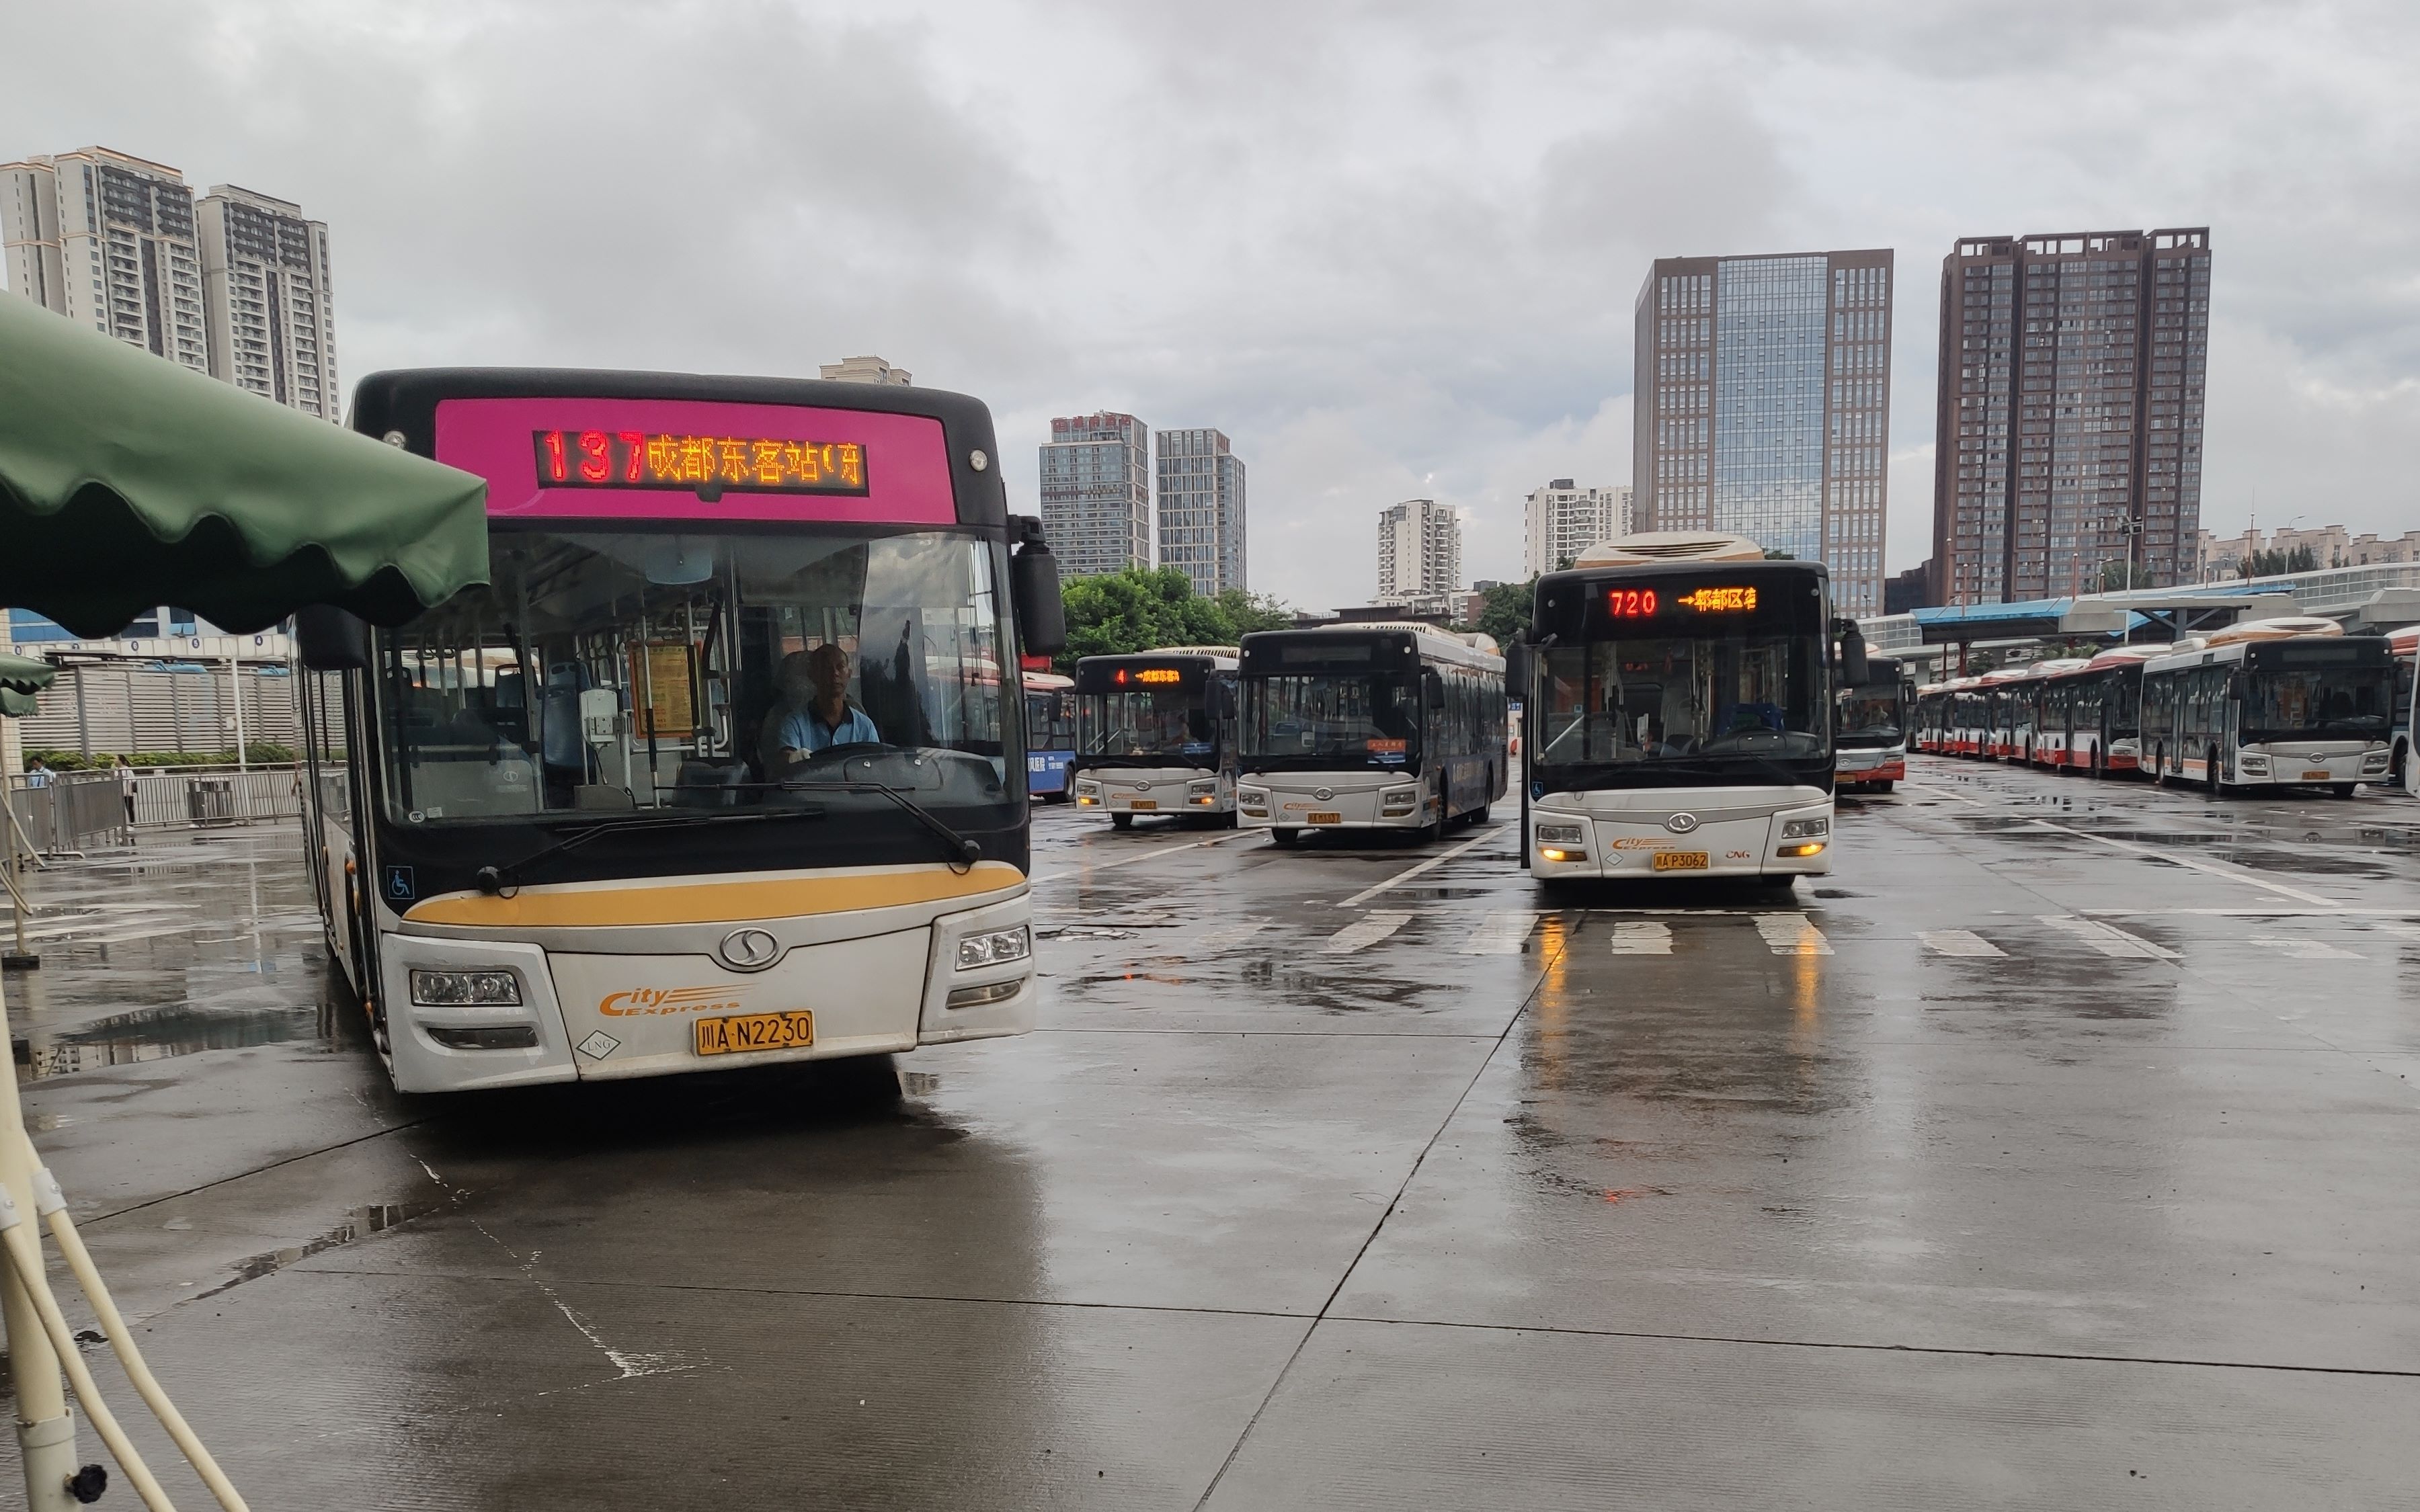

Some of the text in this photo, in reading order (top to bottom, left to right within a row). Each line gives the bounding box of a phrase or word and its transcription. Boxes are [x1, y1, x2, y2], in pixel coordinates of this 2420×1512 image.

[547, 429, 643, 480] 137
[1611, 591, 1656, 616] 720
[1612, 837, 1644, 850] City
[1725, 849, 1750, 859] CNG
[599, 988, 670, 1017] City
[624, 1001, 740, 1016] Express
[586, 1039, 611, 1052] LNG
